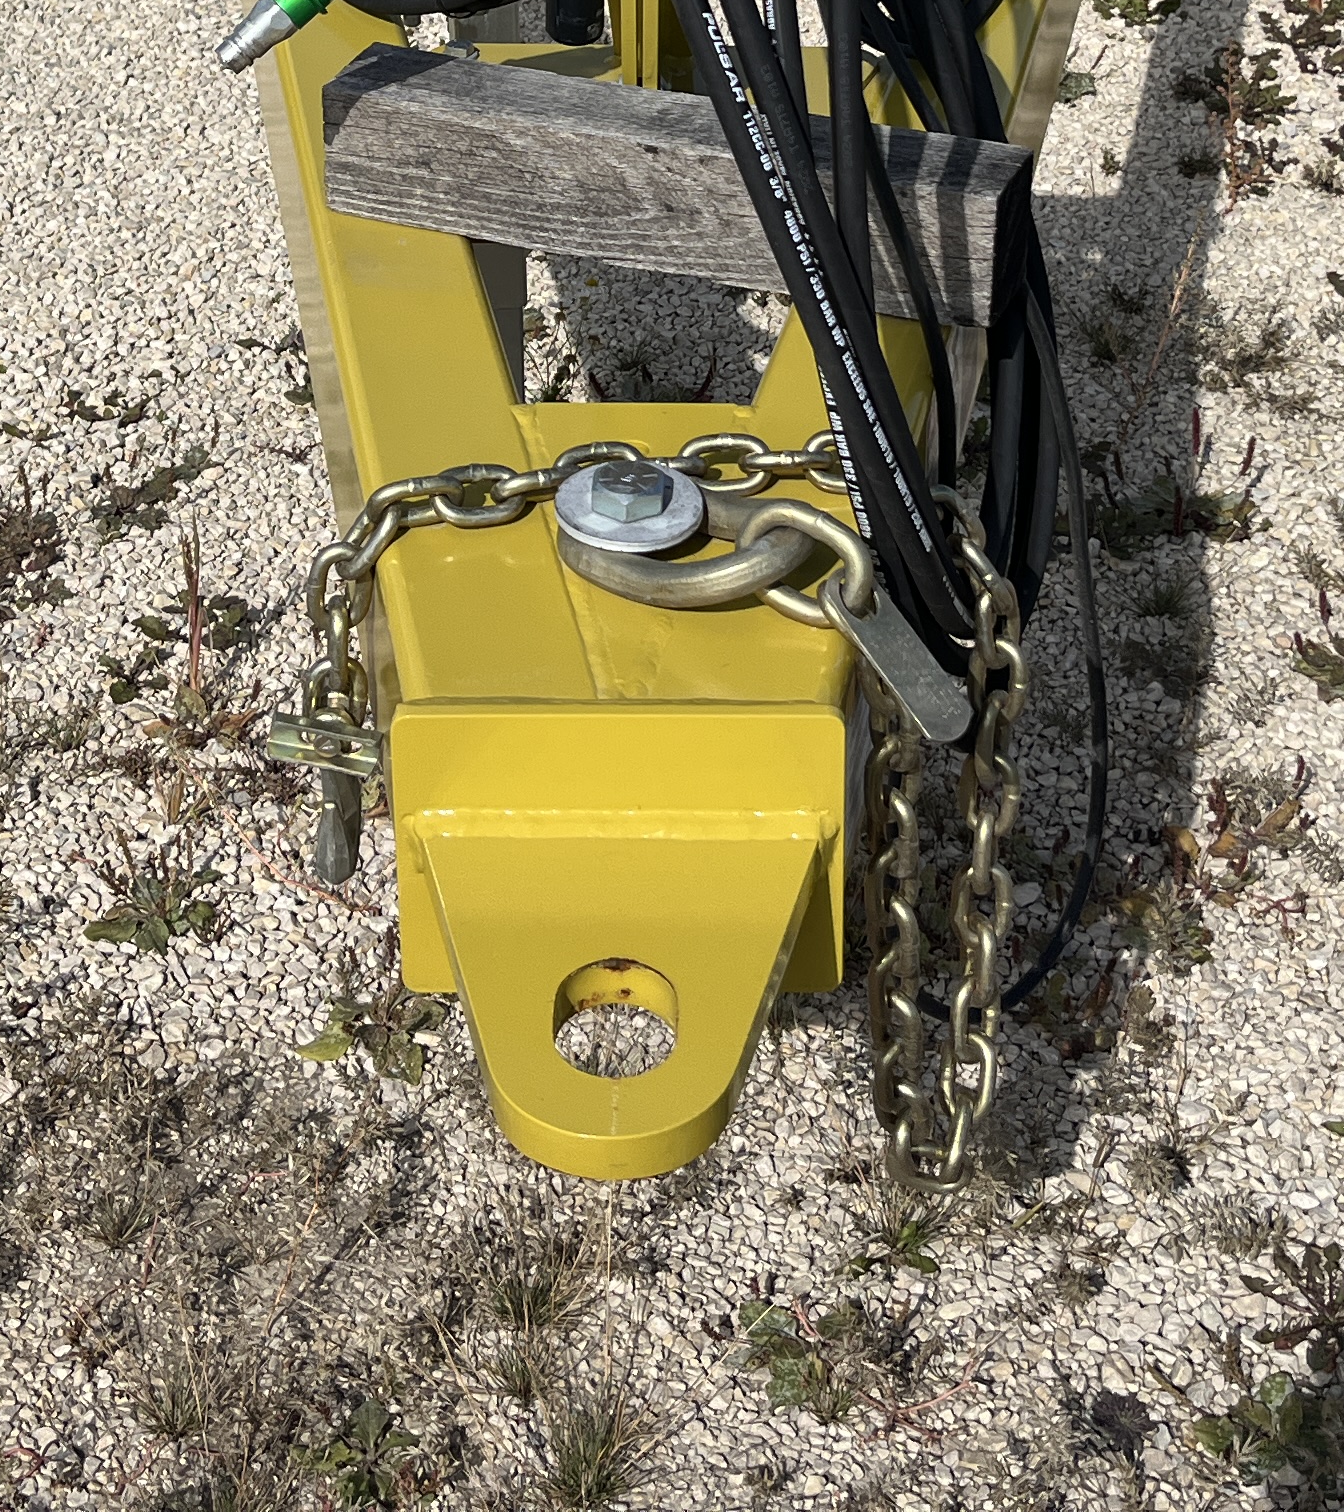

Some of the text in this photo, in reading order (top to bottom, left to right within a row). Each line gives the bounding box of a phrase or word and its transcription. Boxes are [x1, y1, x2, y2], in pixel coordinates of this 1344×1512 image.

[702, 12, 746, 103] PULSAR
[796, 243, 812, 266] PSI
[809, 273, 826, 300] 330
[819, 300, 837, 327] BAR
[831, 325, 846, 347] WP
[829, 411, 845, 433] WP
[834, 433, 851, 459] BAR
[842, 459, 858, 486] 330
[849, 488, 865, 511] PSI
